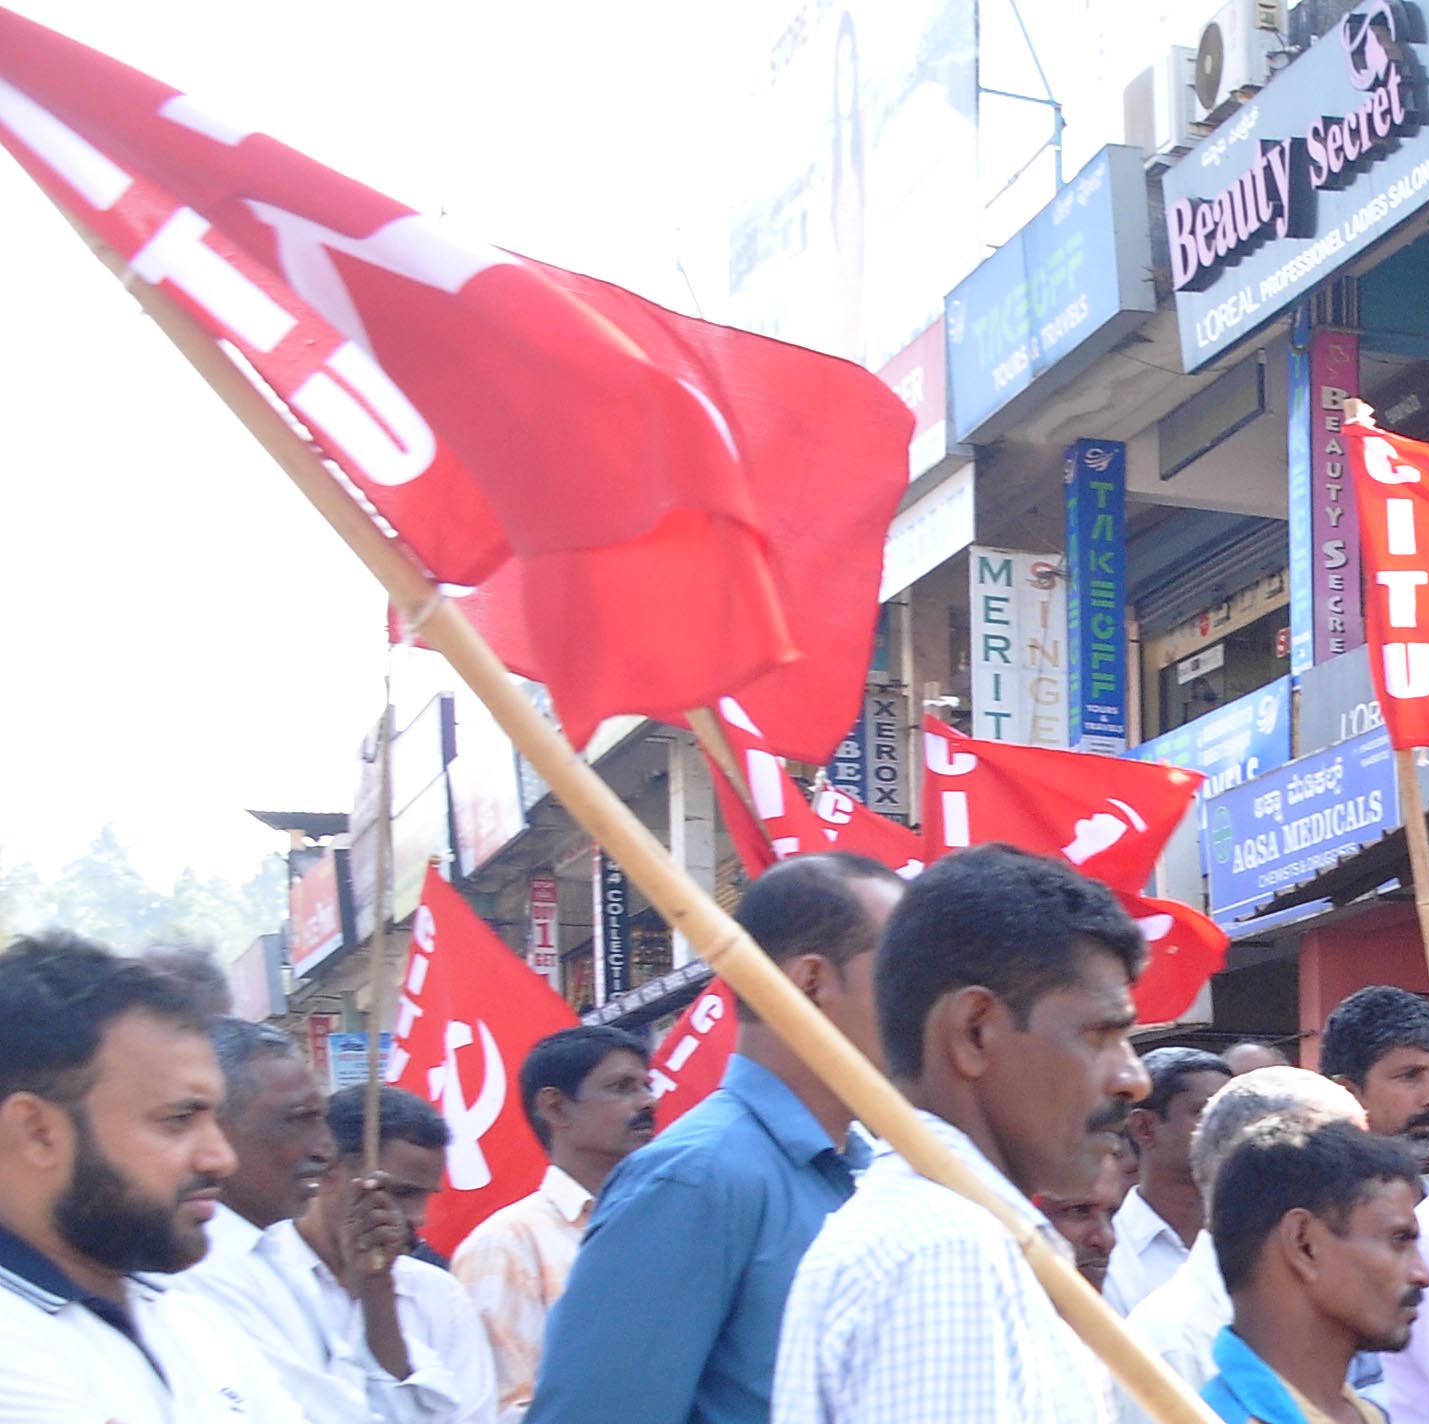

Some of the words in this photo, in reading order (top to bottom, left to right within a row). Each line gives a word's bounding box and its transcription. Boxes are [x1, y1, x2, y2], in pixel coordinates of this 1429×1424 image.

[1167, 137, 1292, 292] Beauty
[1306, 66, 1405, 187] Secret
[1195, 287, 1260, 348] L'OREAL
[1344, 193, 1388, 241] LADIES
[1320, 385, 1347, 528] BEAUTY
[978, 556, 1013, 740] MERIT
[873, 700, 899, 804] XEROX
[1232, 832, 1281, 874] AQSA
[1282, 790, 1383, 854] MEDICALS
